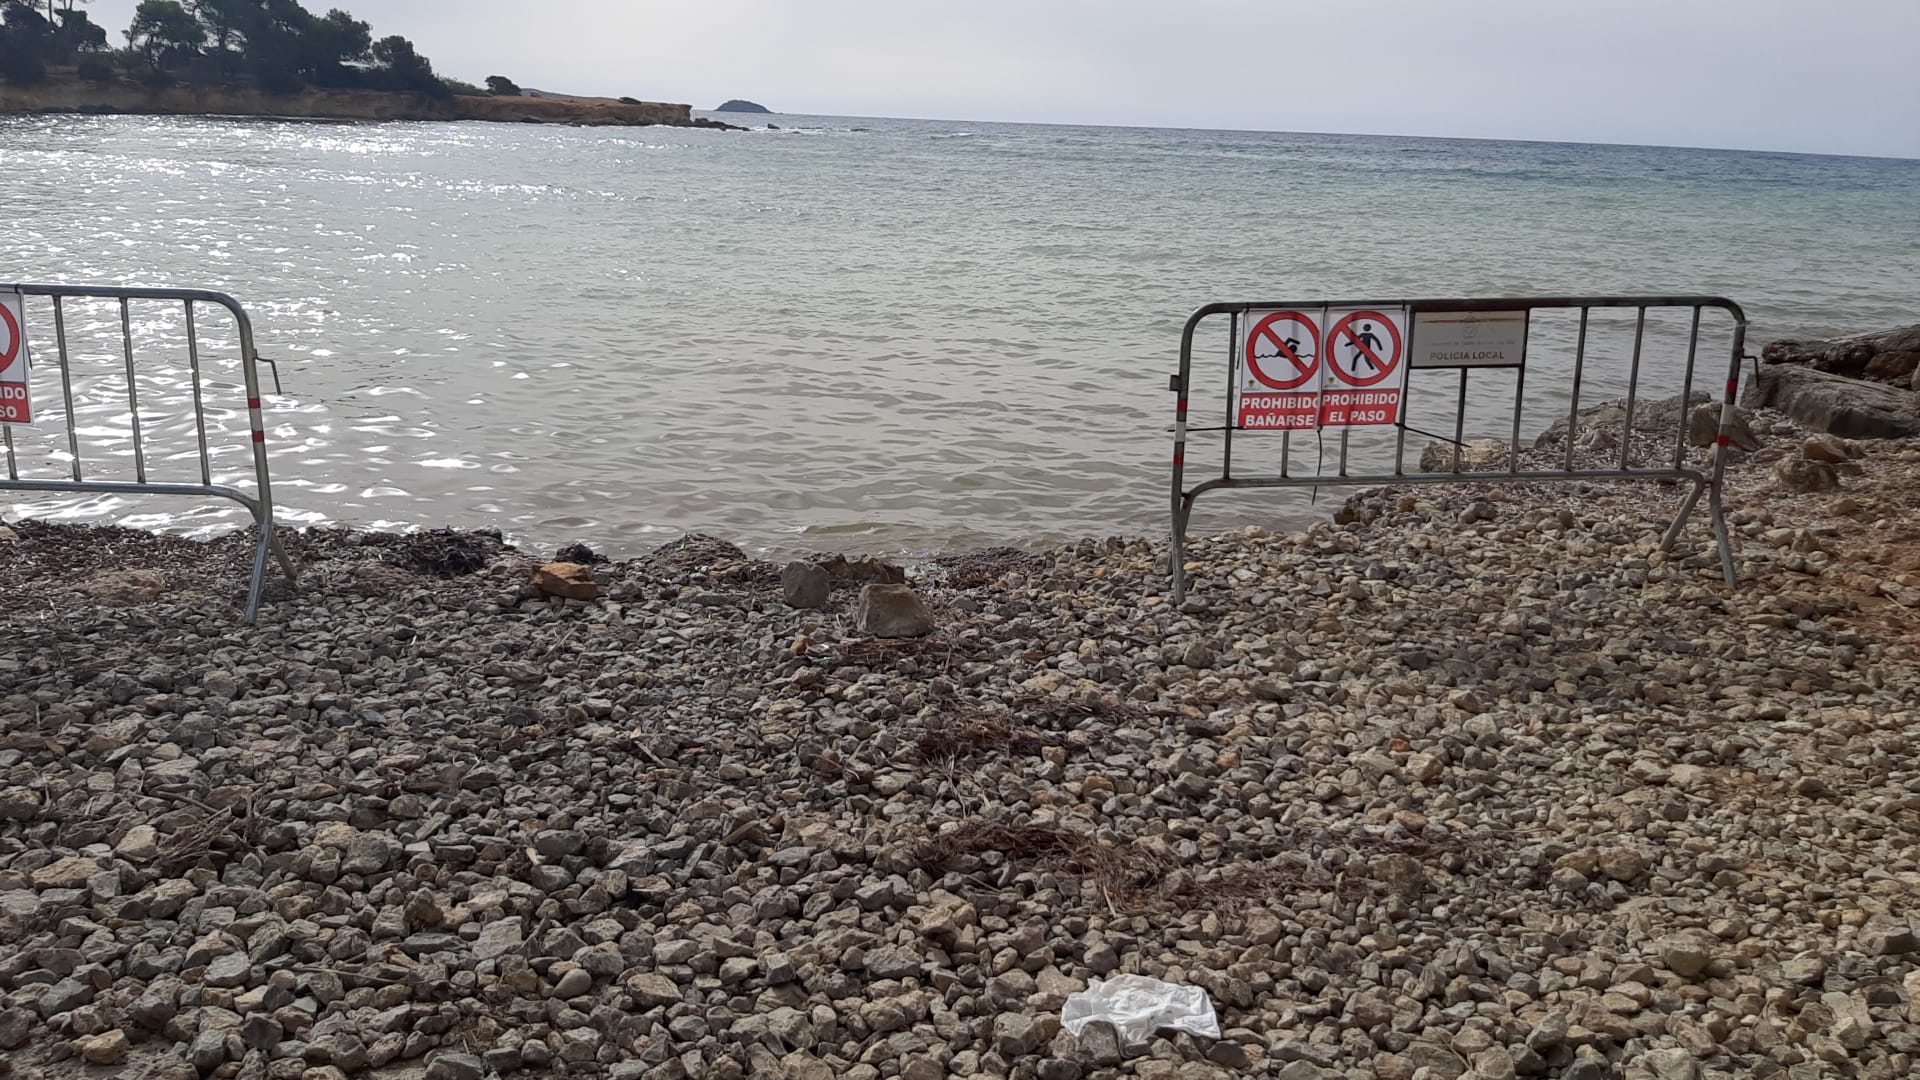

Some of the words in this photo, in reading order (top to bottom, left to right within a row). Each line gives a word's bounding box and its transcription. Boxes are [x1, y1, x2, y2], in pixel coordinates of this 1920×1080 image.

[1430, 352, 1470, 360] POLICIA
[1472, 351, 1504, 360] LOCAL
[1322, 393, 1398, 406] PROHIBIDO
[1245, 413, 1315, 427] BAÑARSE
[1329, 411, 1346, 423] EL
[1350, 410, 1386, 422] PASO
